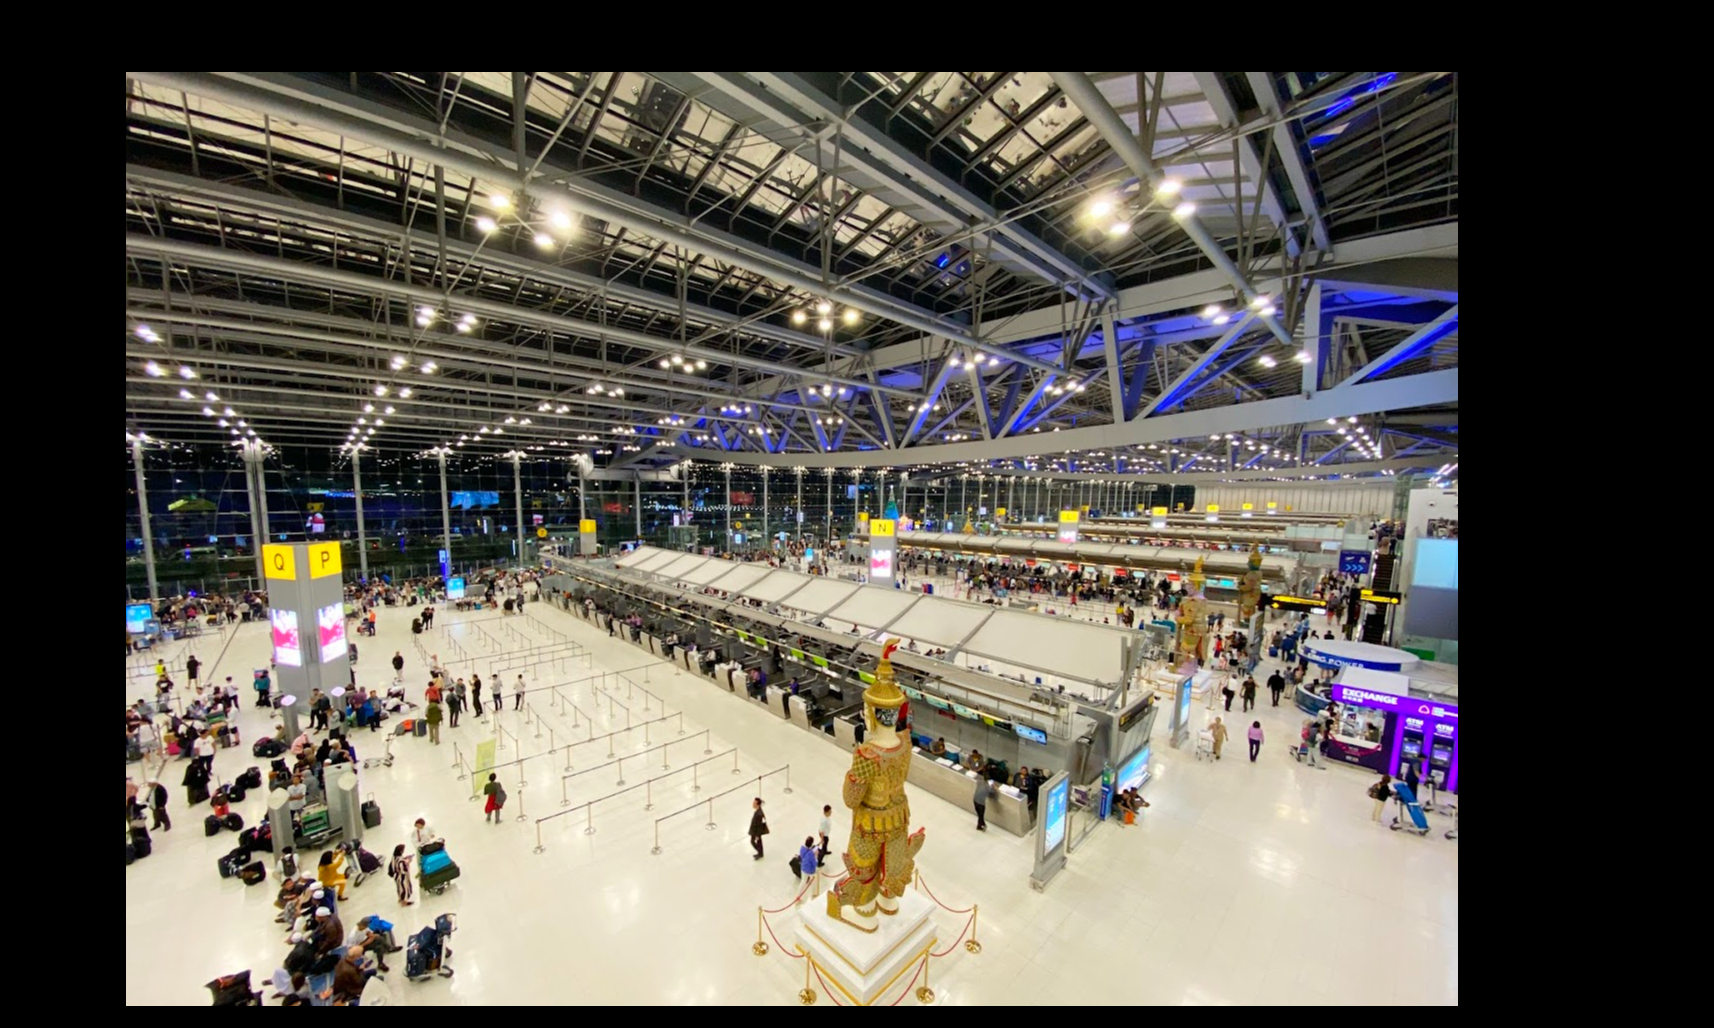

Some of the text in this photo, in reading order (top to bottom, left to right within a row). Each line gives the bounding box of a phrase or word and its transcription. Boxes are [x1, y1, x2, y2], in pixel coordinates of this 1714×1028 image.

[878, 523, 887, 533] N
[274, 553, 285, 571] Q
[321, 550, 330, 569] P
[1342, 687, 1398, 705] EXCHANGE
[1406, 717, 1424, 726] ATM
[1436, 723, 1454, 732] ATM
